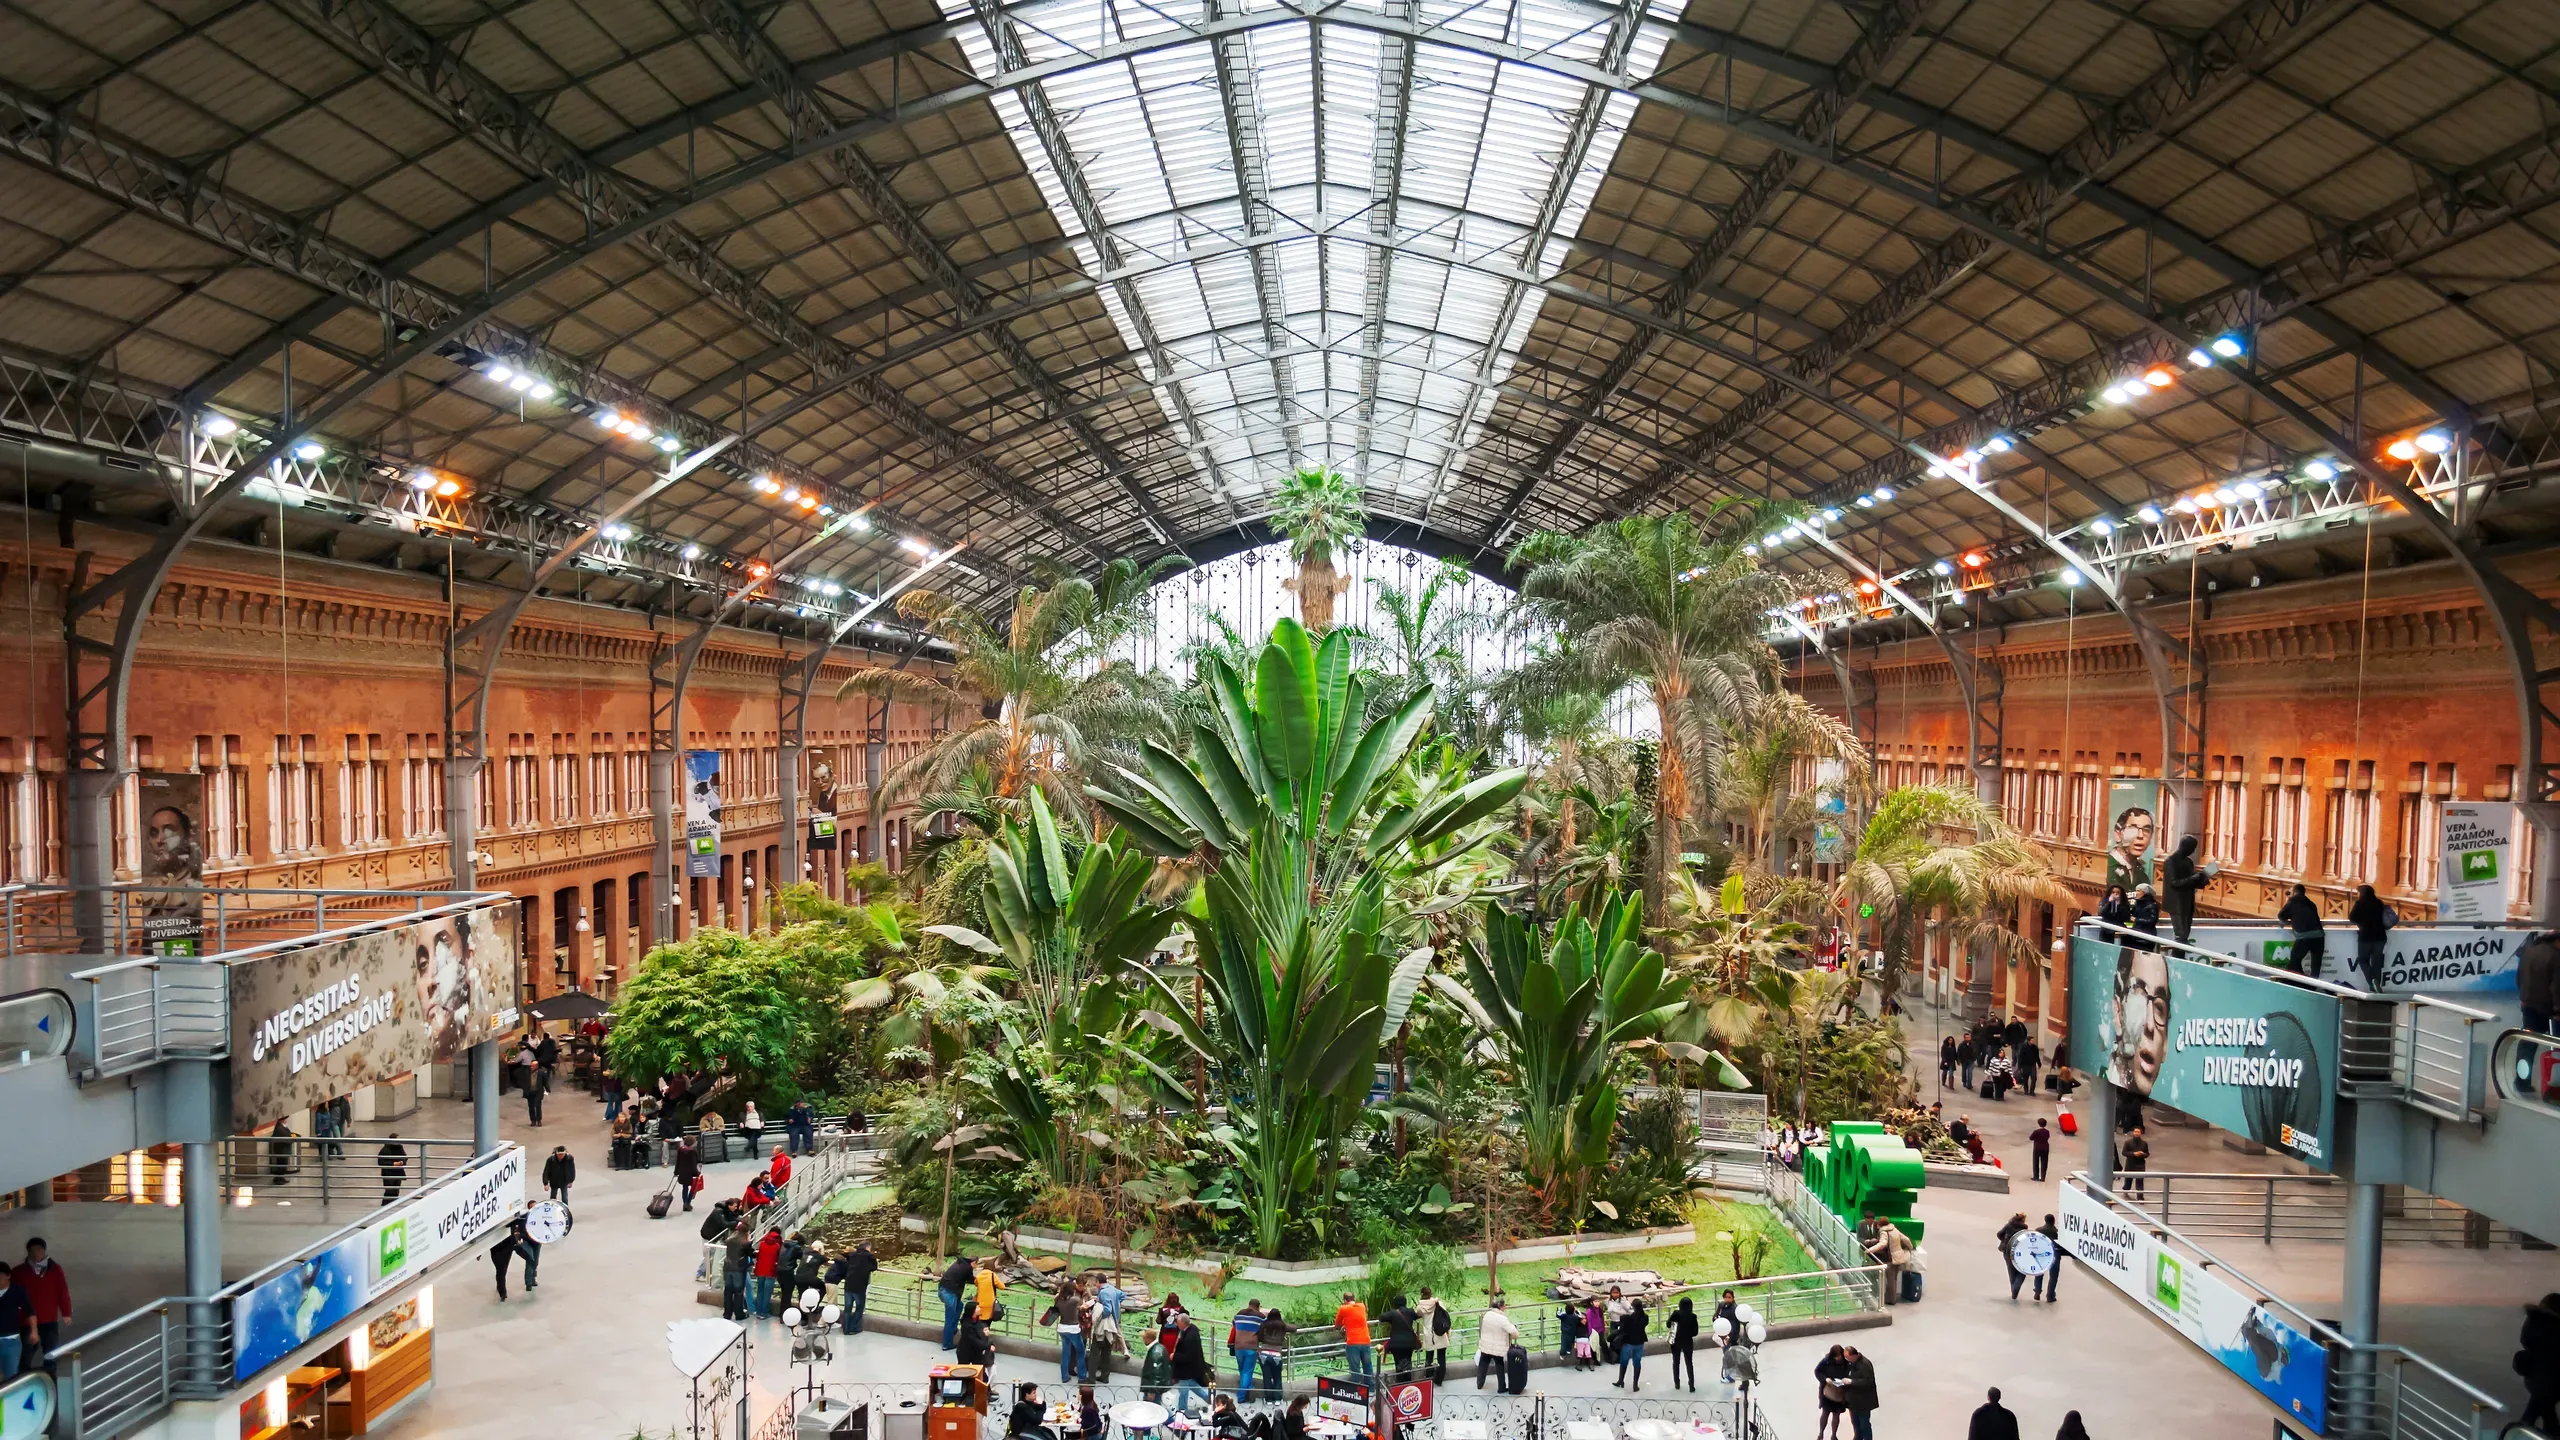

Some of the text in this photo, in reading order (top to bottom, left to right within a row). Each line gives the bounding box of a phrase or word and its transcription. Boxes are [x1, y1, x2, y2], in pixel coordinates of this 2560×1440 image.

[2446, 822, 2477, 833] VEN A
[2446, 828, 2495, 842] ARAMÓN
[2447, 837, 2510, 851] PANTICOSA.
[2391, 952, 2406, 967] A
[2411, 936, 2504, 965] ARAMÓN
[2381, 960, 2491, 987] FORMIGAL.
[252, 972, 361, 1063] ¿NECESITAS
[292, 991, 394, 1075] DIVERSIÓN?
[2175, 1017, 2268, 1052] ¿NECESITAS
[2203, 1049, 2303, 1089] DIVERSIÓN?
[438, 1207, 460, 1240] VEN
[462, 1200, 470, 1220] A
[473, 1157, 518, 1211] ARAMÓN
[460, 1196, 500, 1241] CERLER.
[2063, 1212, 2135, 1251] VEN A ARAMÓN
[2078, 1238, 2129, 1272] FORMIGAL.
[1401, 1395, 1419, 1409] KING
